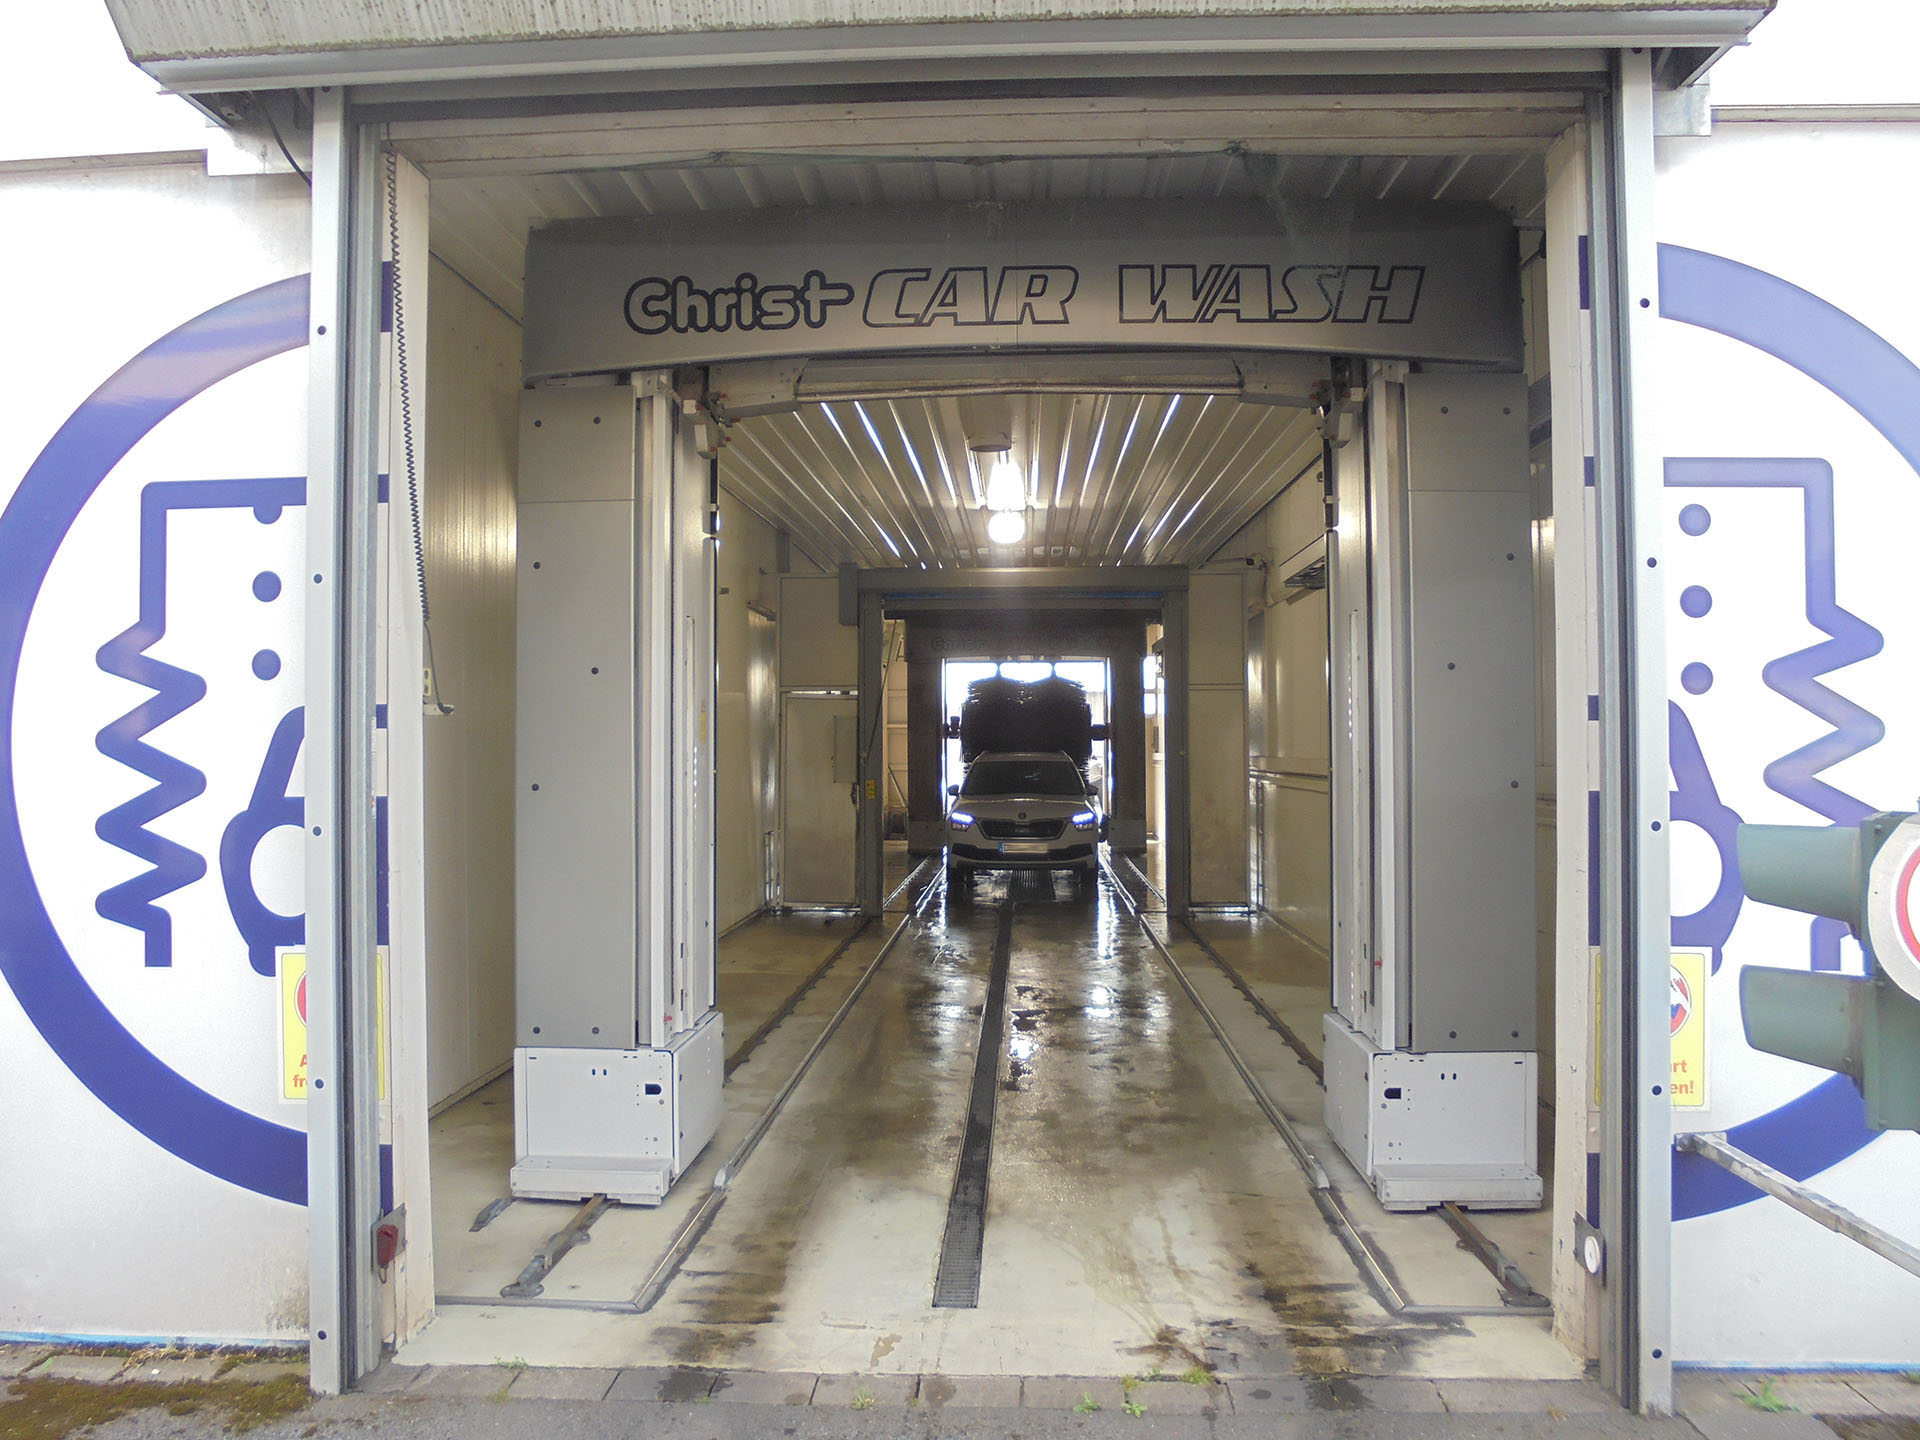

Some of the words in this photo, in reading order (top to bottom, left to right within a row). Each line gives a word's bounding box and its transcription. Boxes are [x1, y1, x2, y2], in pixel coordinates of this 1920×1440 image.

[624, 270, 853, 334] Christ
[863, 265, 1078, 326] CAR
[1119, 264, 1425, 323] WASH
